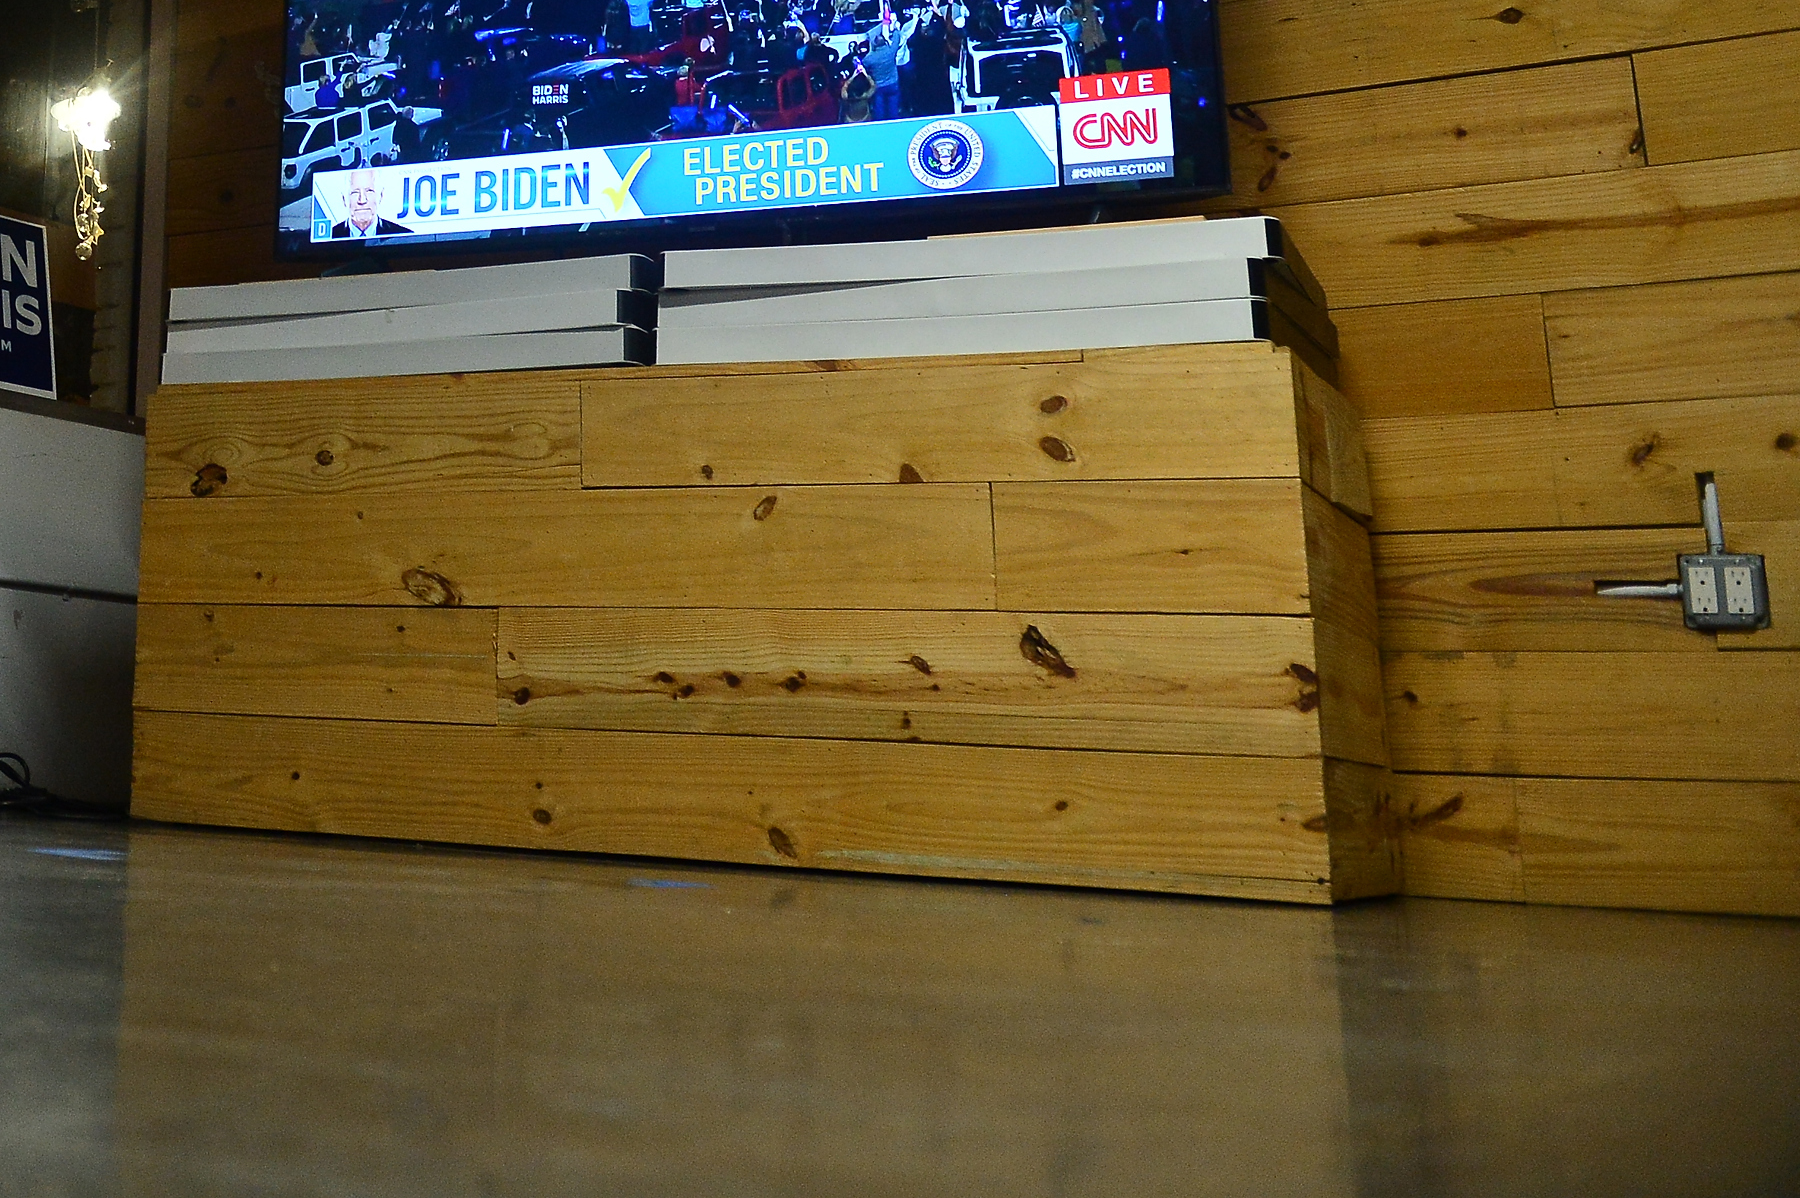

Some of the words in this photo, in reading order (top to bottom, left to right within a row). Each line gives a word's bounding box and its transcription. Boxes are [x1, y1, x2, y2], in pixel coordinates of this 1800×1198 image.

[532, 83, 569, 96] BIDEN
[1074, 73, 1154, 99] LIVE
[532, 94, 569, 105] HARRIS
[1072, 108, 1158, 149] CNN
[683, 136, 829, 176] ELECTED
[695, 162, 885, 205] PRESIDENT
[1071, 161, 1166, 180] #CNNELECTION
[397, 172, 461, 219] JOE
[474, 161, 590, 214] BIDEN
[318, 222, 327, 235] D
